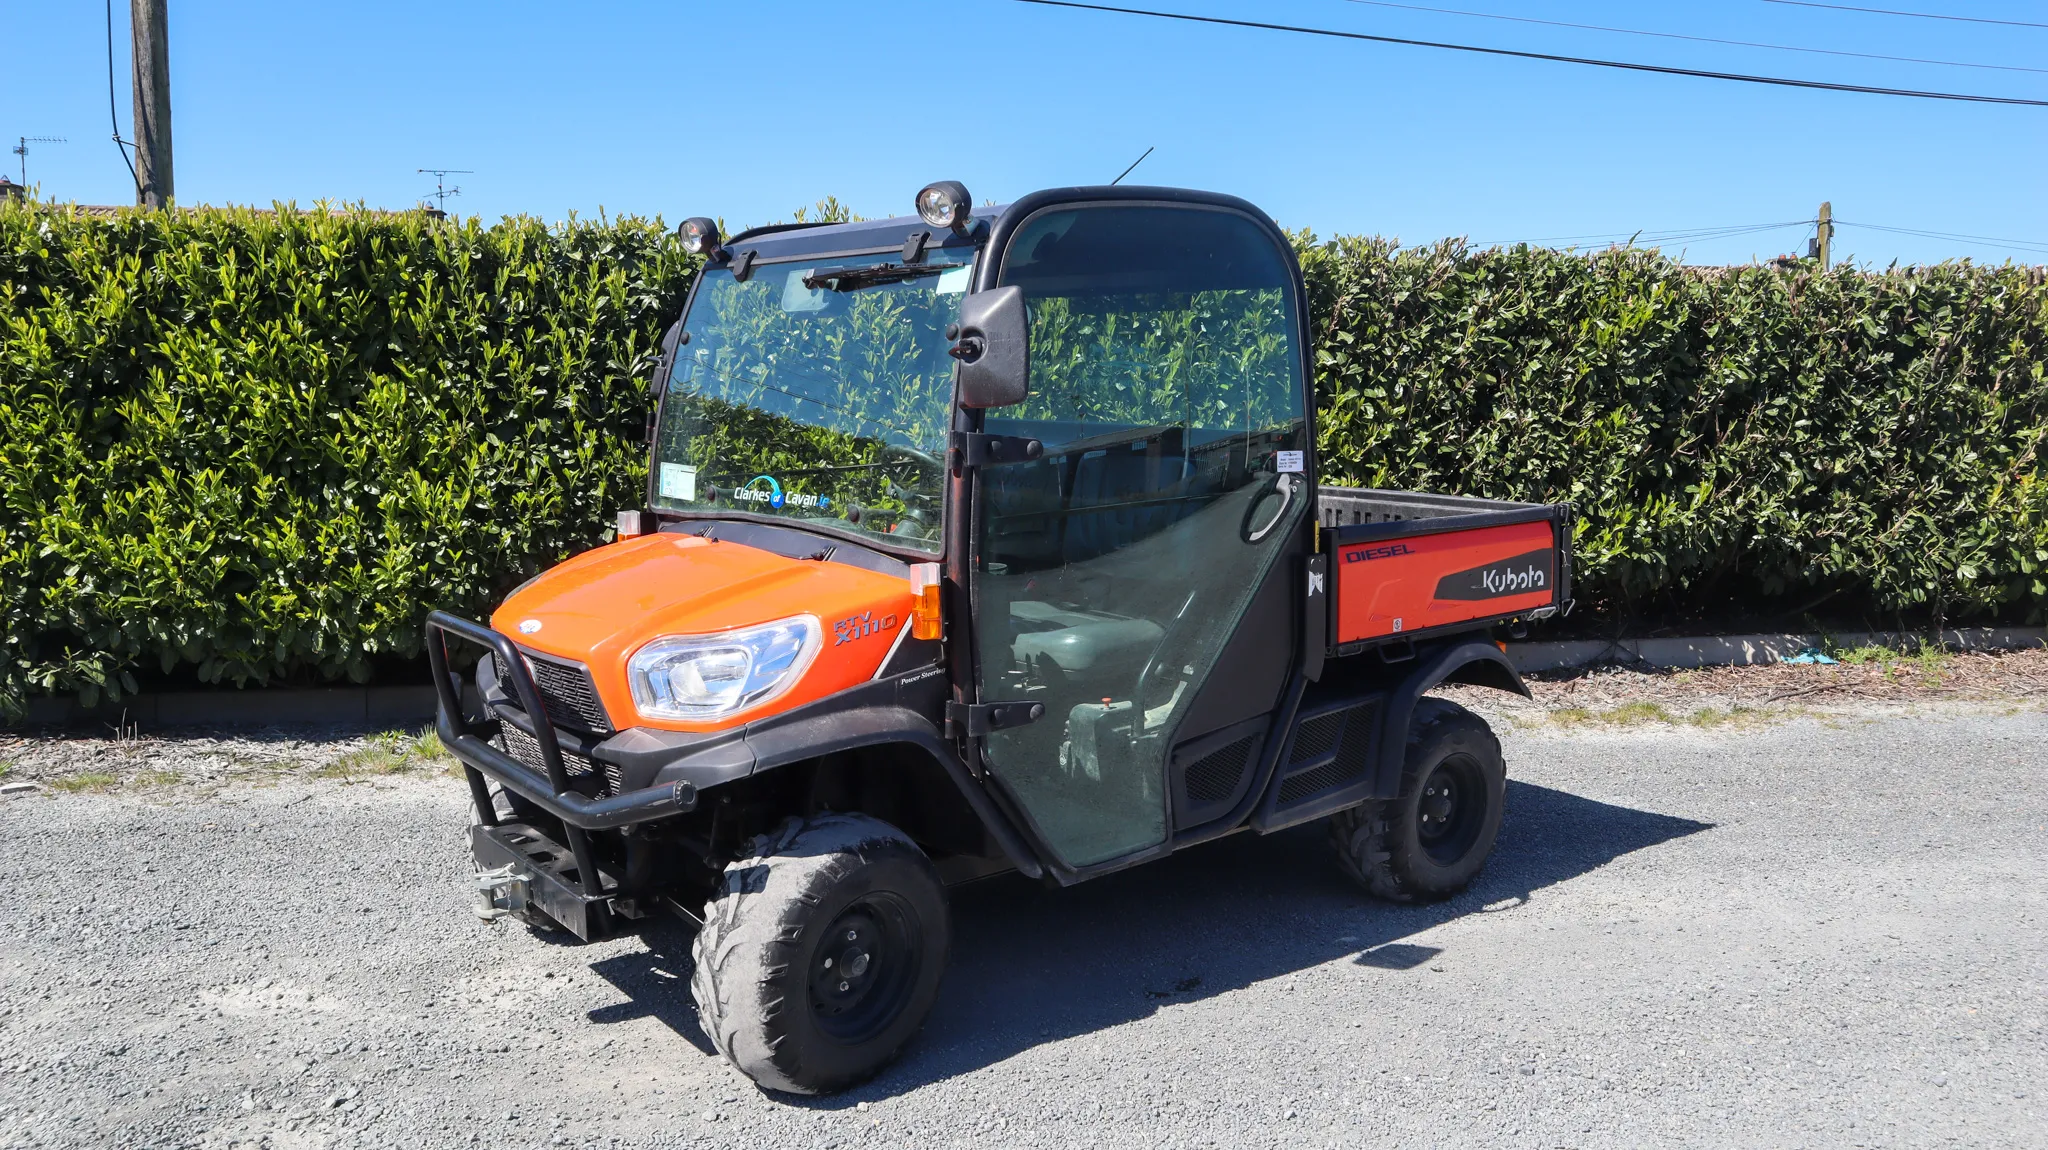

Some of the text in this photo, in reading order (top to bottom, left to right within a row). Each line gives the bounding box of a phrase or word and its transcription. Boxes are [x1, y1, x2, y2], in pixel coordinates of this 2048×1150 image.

[734, 487, 831, 508] Clarkes of Cavan.ie
[1346, 544, 1415, 563] DIESEL
[1483, 564, 1545, 593] Kubota
[833, 611, 872, 632] RTV
[834, 613, 898, 646] X1110
[901, 675, 920, 685] Power
